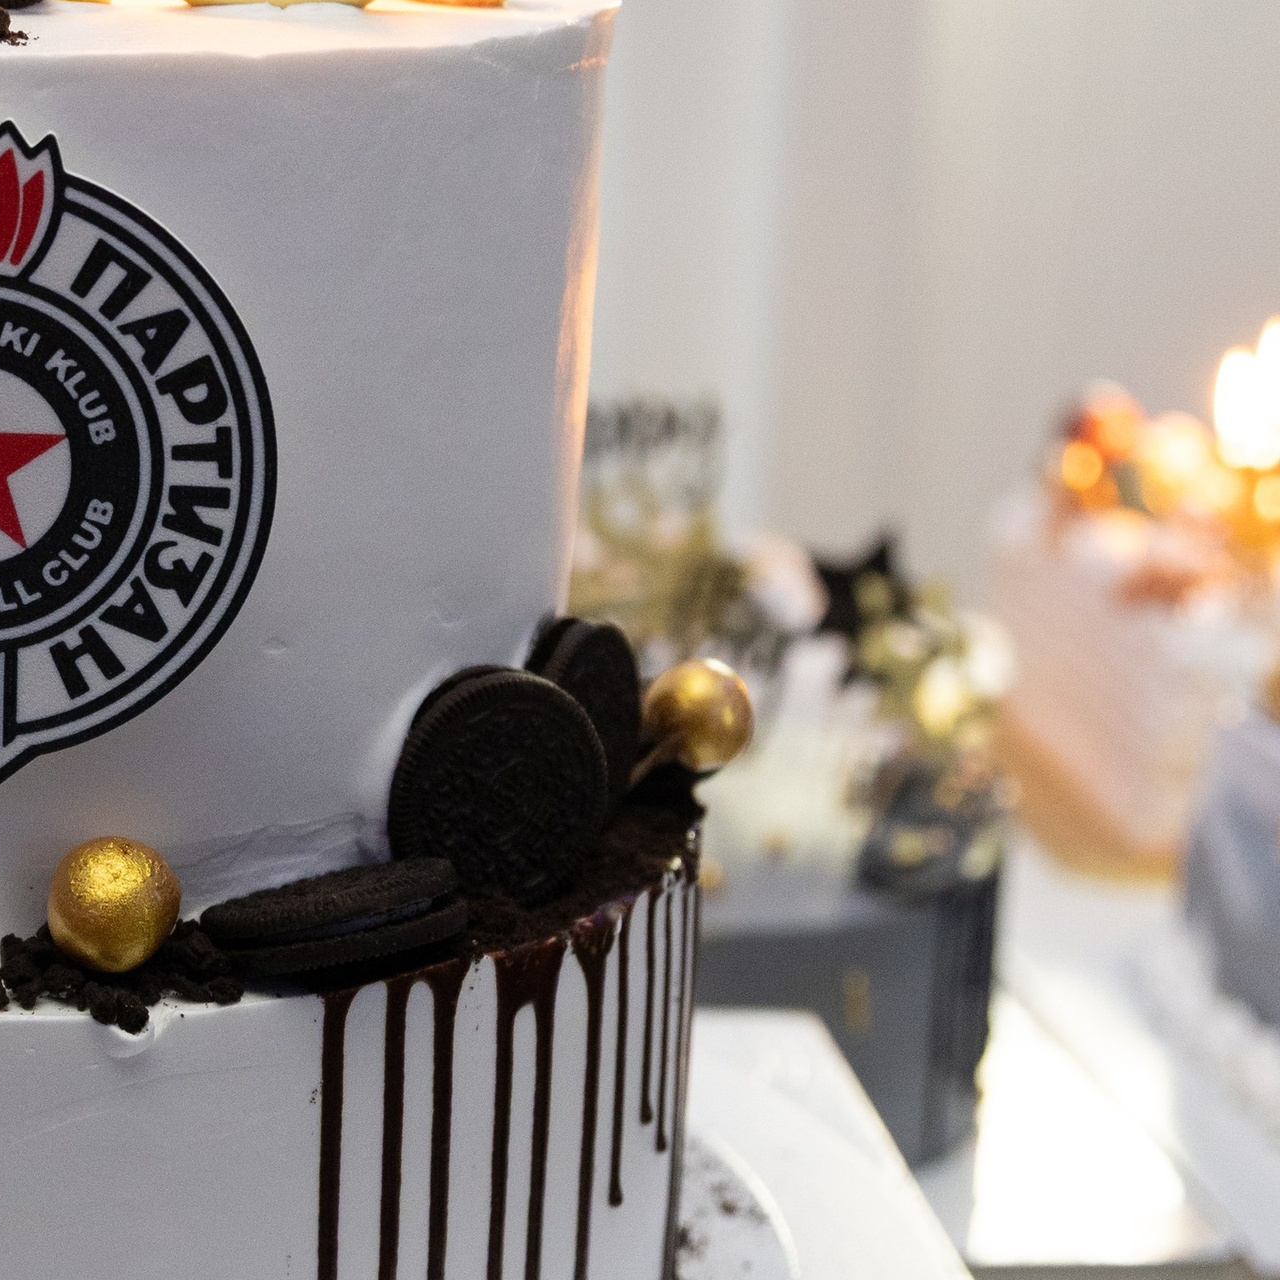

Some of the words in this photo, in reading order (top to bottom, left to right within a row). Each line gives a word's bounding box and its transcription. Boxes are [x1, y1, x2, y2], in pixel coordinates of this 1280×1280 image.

[44, 348, 117, 447] KLUB
[49, 237, 233, 700] ПАРТИЗАН
[41, 497, 115, 588] CLUB
